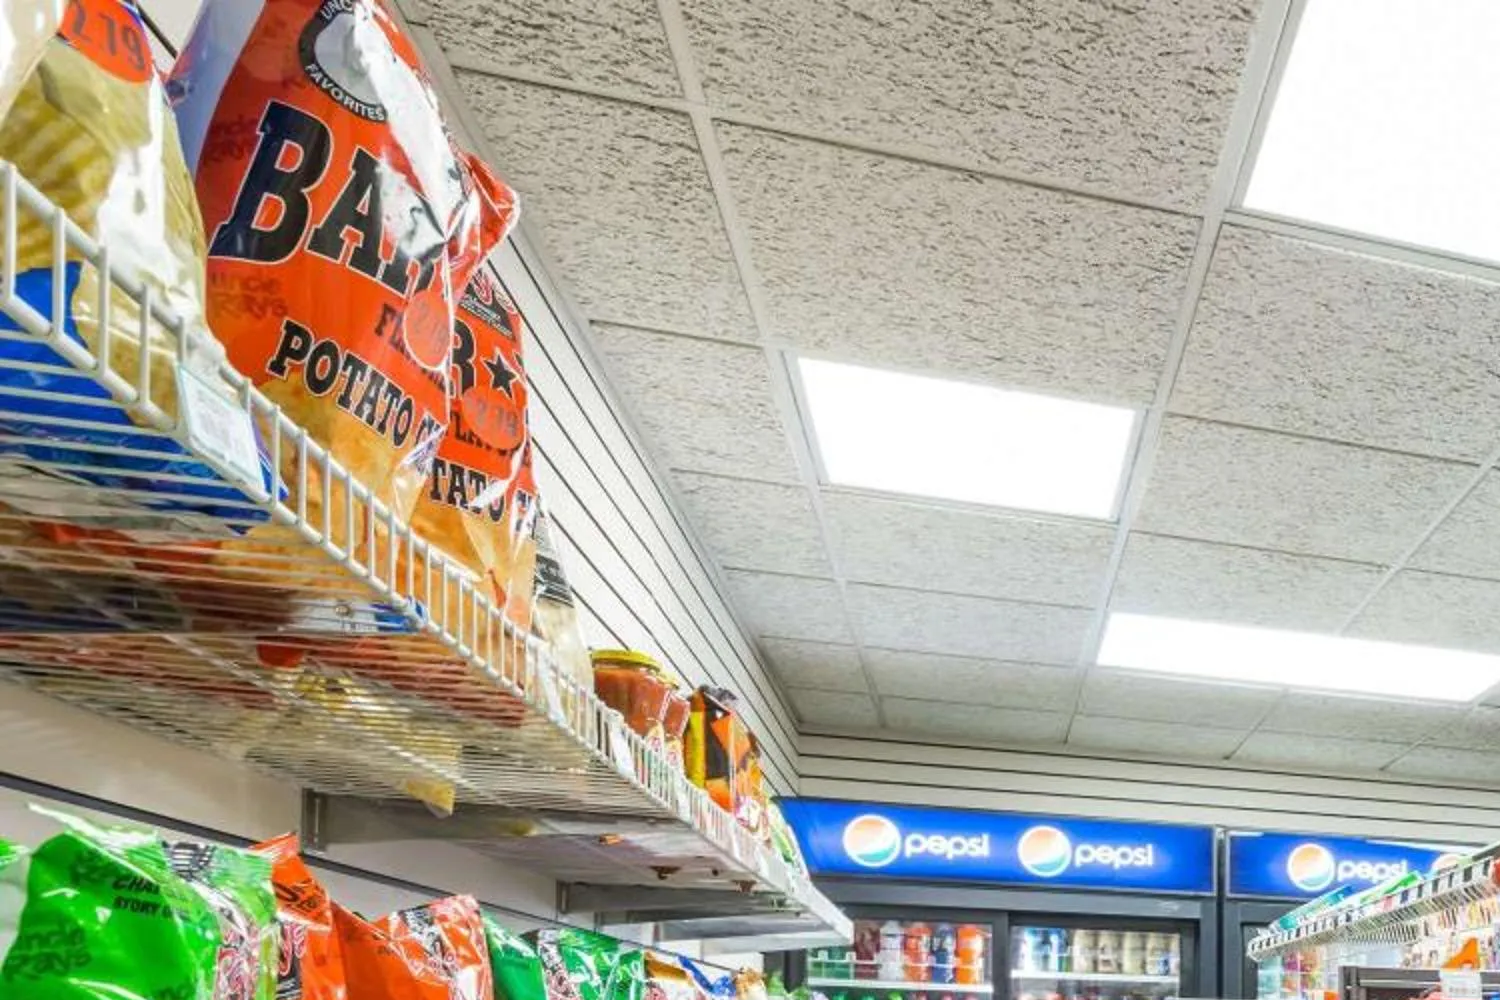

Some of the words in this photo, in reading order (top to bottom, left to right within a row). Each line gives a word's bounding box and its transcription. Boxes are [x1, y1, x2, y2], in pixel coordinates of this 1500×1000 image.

[304, 62, 386, 121] FAVORITES
[267, 319, 414, 447] POTATO
[905, 832, 990, 858] pepsi
[1075, 843, 1154, 868] pepsi
[1337, 859, 1407, 884] pepsi
